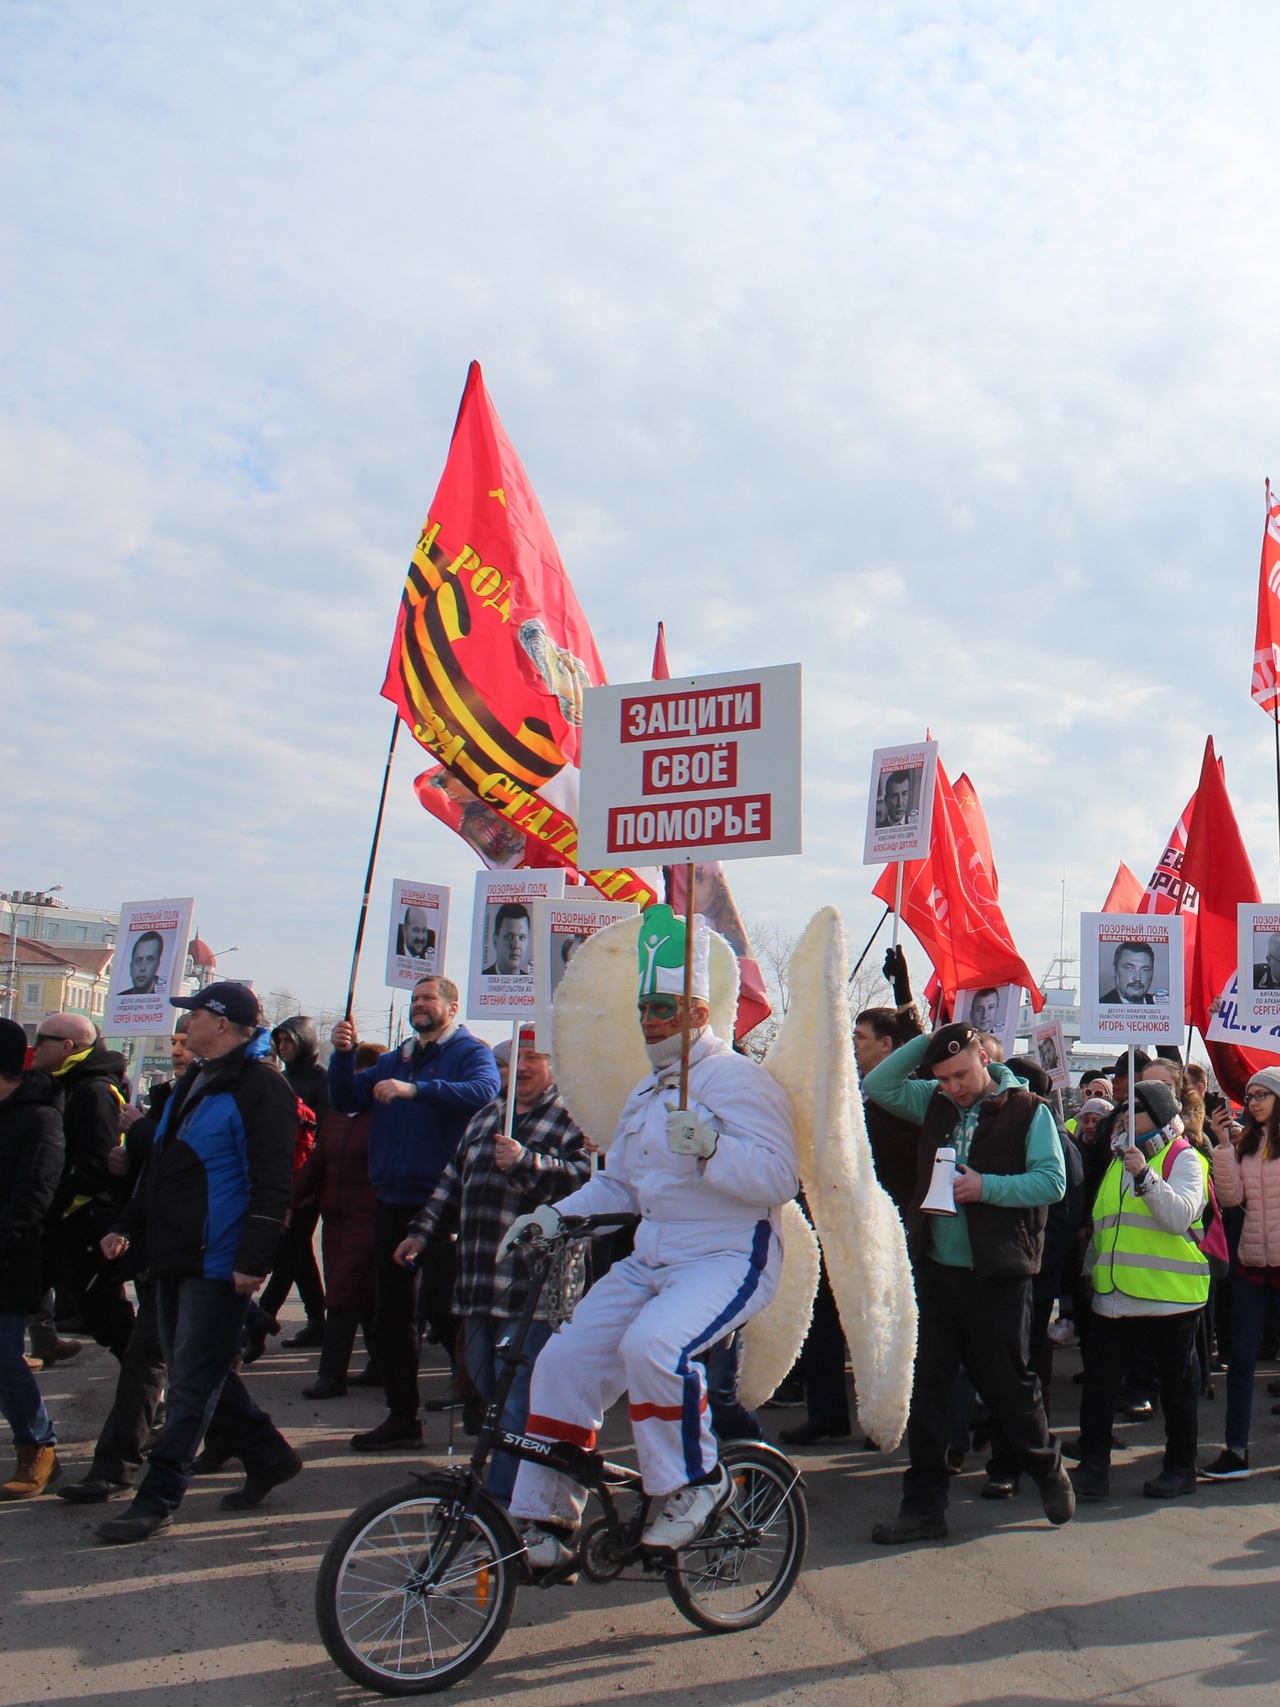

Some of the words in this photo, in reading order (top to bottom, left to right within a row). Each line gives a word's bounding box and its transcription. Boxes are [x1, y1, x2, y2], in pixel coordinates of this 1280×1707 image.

[629, 692, 753, 736] ЗАЩИТИ
[413, 711, 466, 766] ЗА
[651, 742, 729, 788] СВОЁ
[616, 802, 762, 846] ПОМОРЬЕ
[487, 882, 525, 894] ПОЗОРНЫЙ
[528, 883, 548, 894] ПОЛК
[551, 912, 596, 925] ПОЗОРНЫЙ
[554, 925, 582, 933] ВЛАСТЬ
[1099, 924, 1144, 934] ПОЗОРНЫЙ
[1147, 926, 1169, 935] ПОЛК
[480, 994, 506, 1005] ЕВГЕНИЙ
[1253, 1004, 1280, 1015] СЕРГЕЙ
[1099, 1021, 1124, 1031] ИГОРЬ
[1126, 1021, 1170, 1032] ЧЕСНОКОВ
[503, 1432, 552, 1455] STERN
